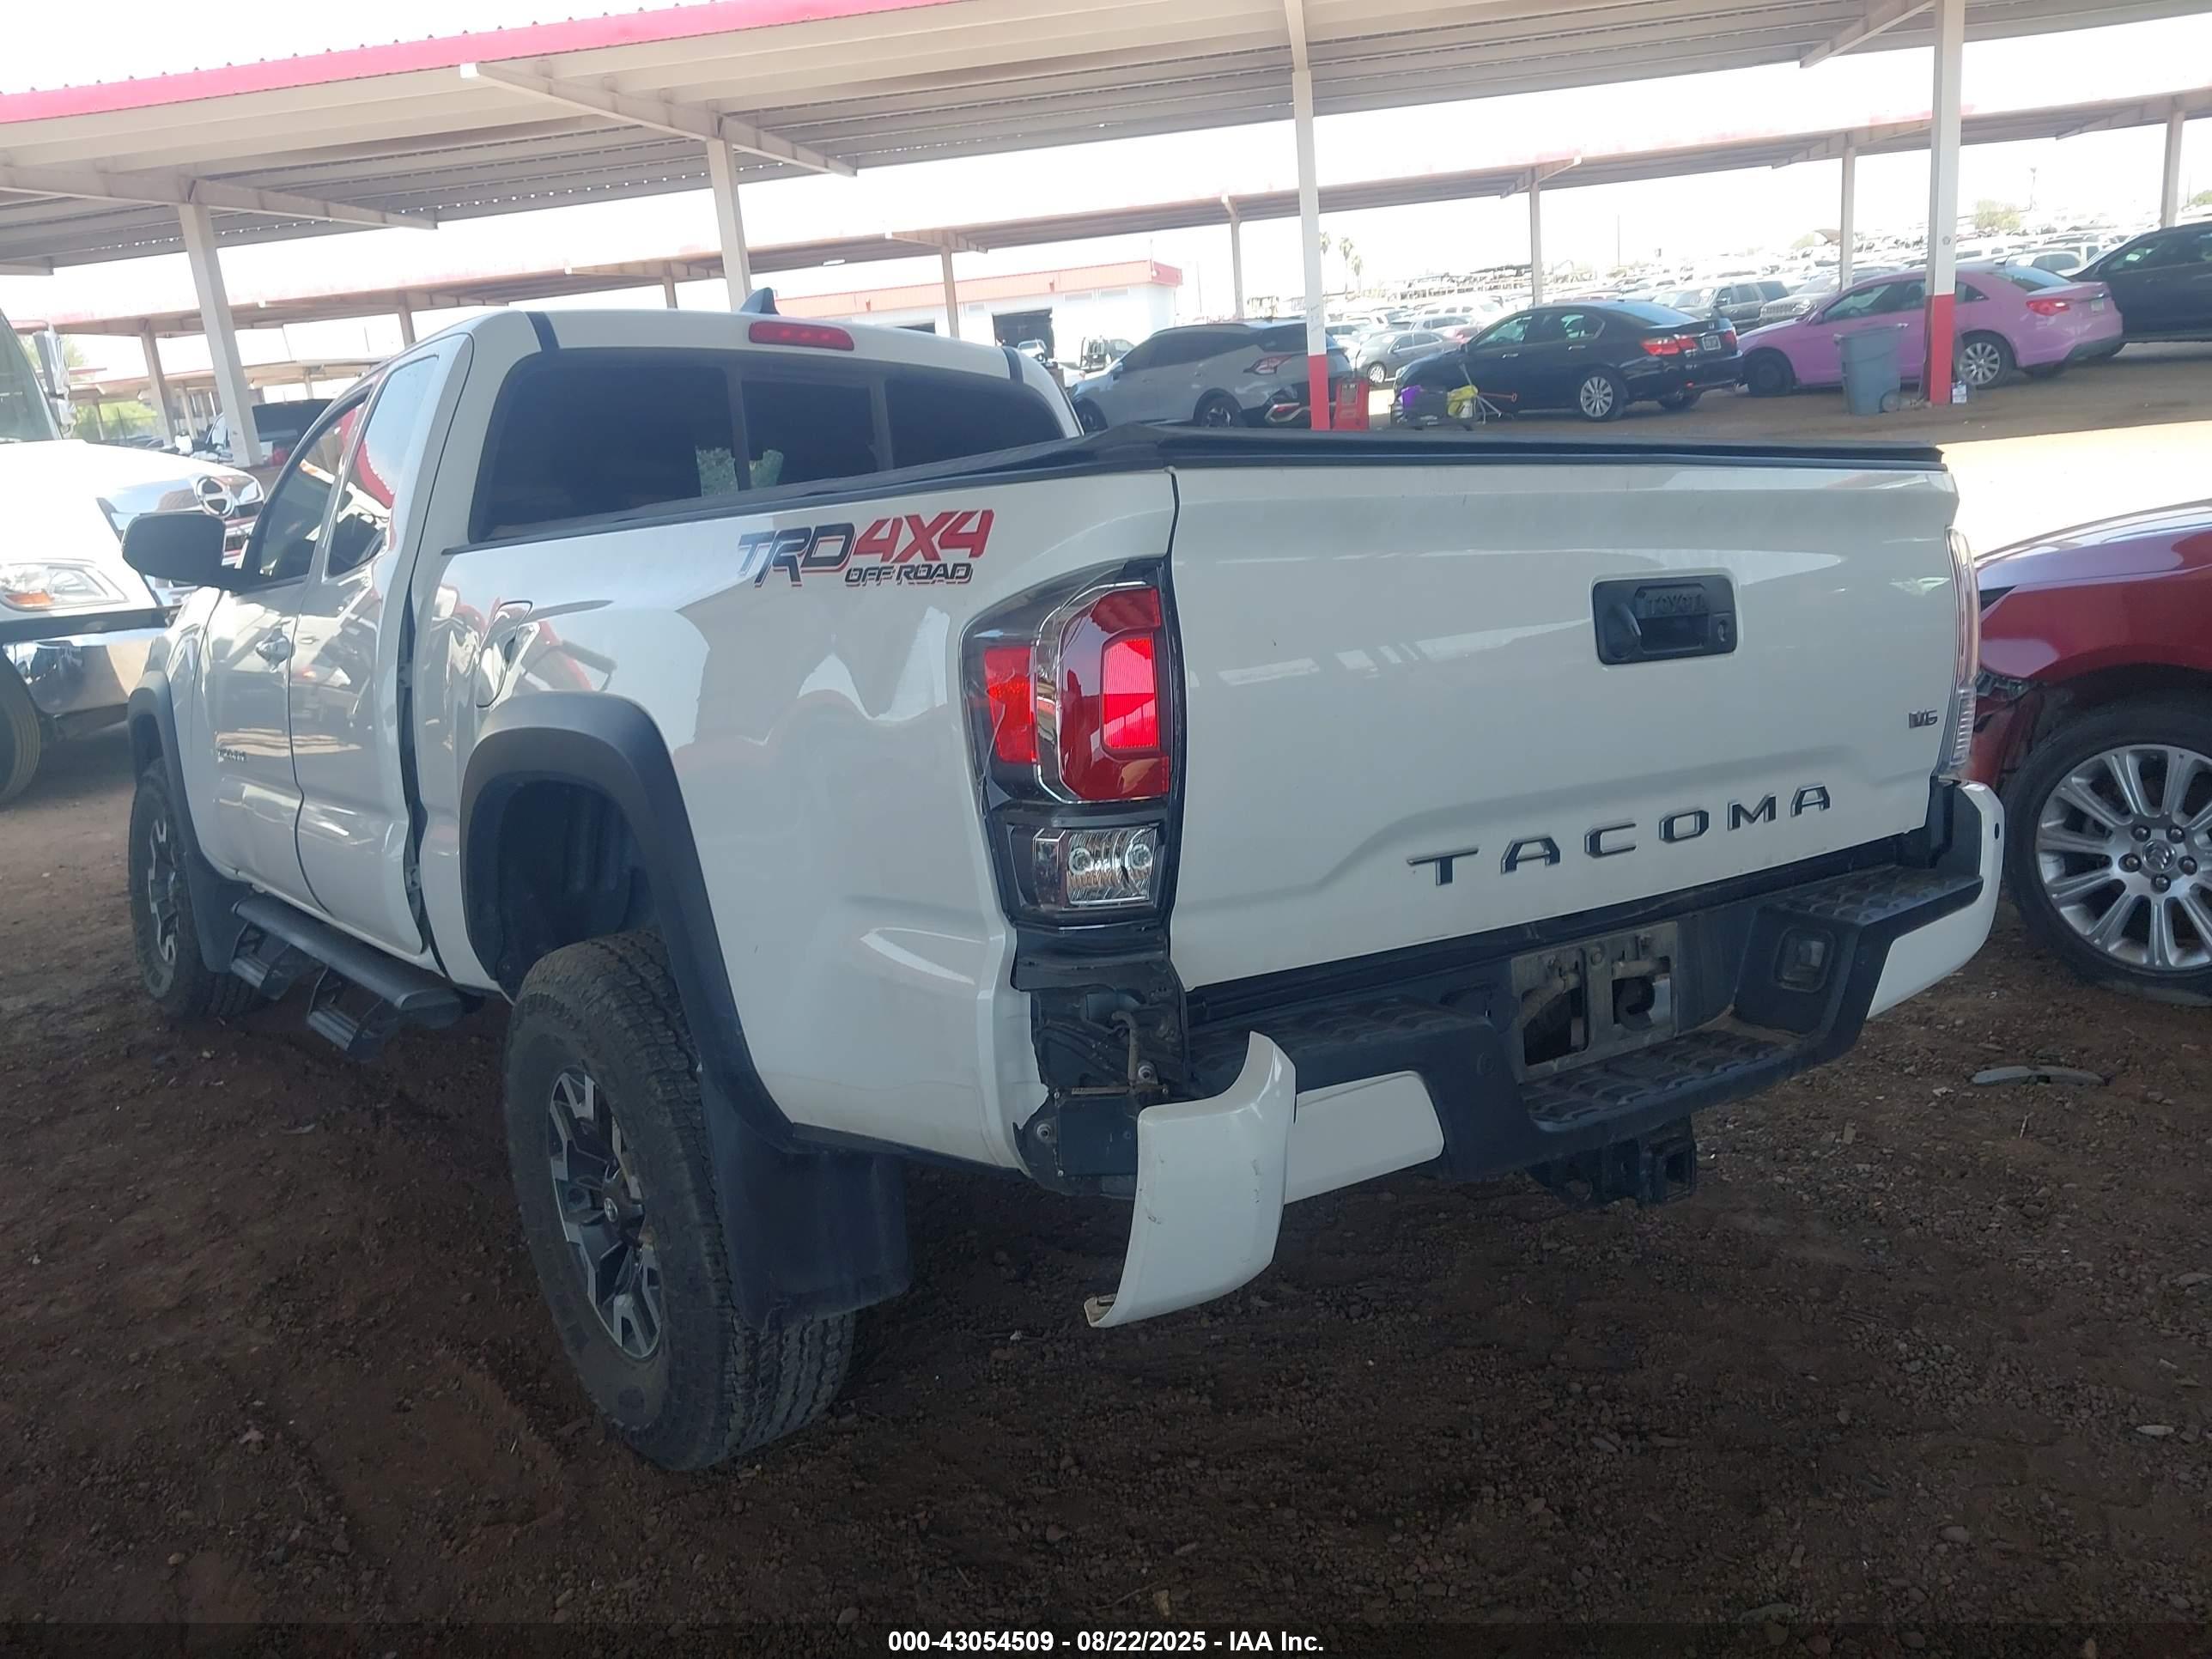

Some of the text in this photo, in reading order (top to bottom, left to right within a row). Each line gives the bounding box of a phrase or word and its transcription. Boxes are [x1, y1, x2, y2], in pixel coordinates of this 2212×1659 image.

[844, 562, 974, 587] OFF ROAD
[1407, 784, 1832, 887] TACOMA
